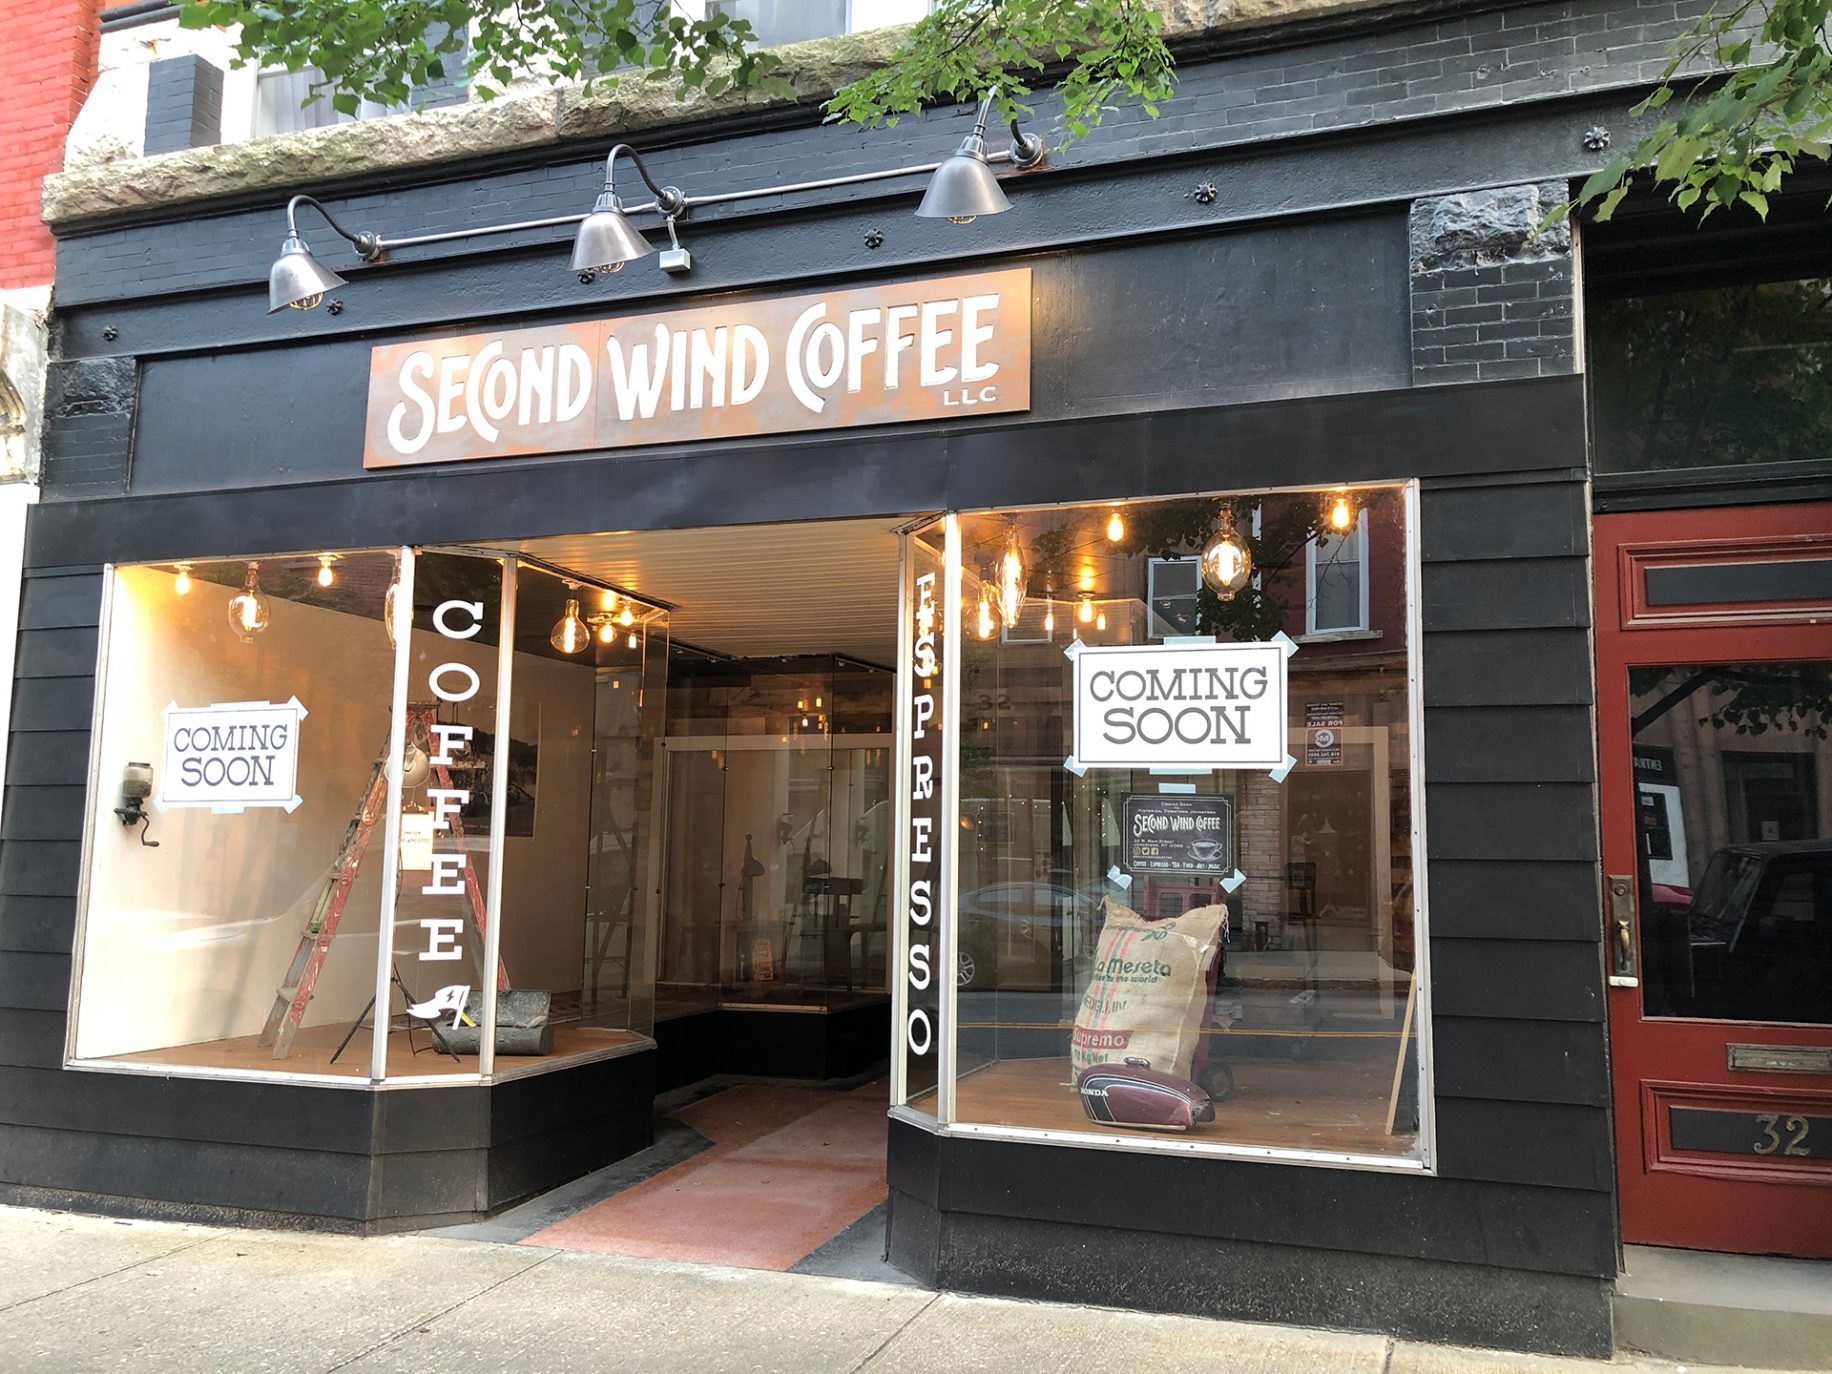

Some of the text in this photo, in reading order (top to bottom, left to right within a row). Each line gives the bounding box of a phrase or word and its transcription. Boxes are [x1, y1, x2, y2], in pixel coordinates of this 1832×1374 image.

[387, 292, 1000, 454] SECOND WIND COFFEE
[943, 385, 998, 406] LLC
[1090, 666, 1268, 702] COMING
[174, 724, 288, 752] COMING
[1103, 705, 1251, 745] SOON
[181, 755, 276, 787] SOON
[419, 600, 484, 961] COFFEE
[907, 571, 936, 1056] ESPRESSO
[1133, 813, 1221, 837] SECOND WIND COFFEE
[1107, 958, 1172, 977] Meseta
[1131, 975, 1158, 984] world
[1753, 1114, 1810, 1156] 32
